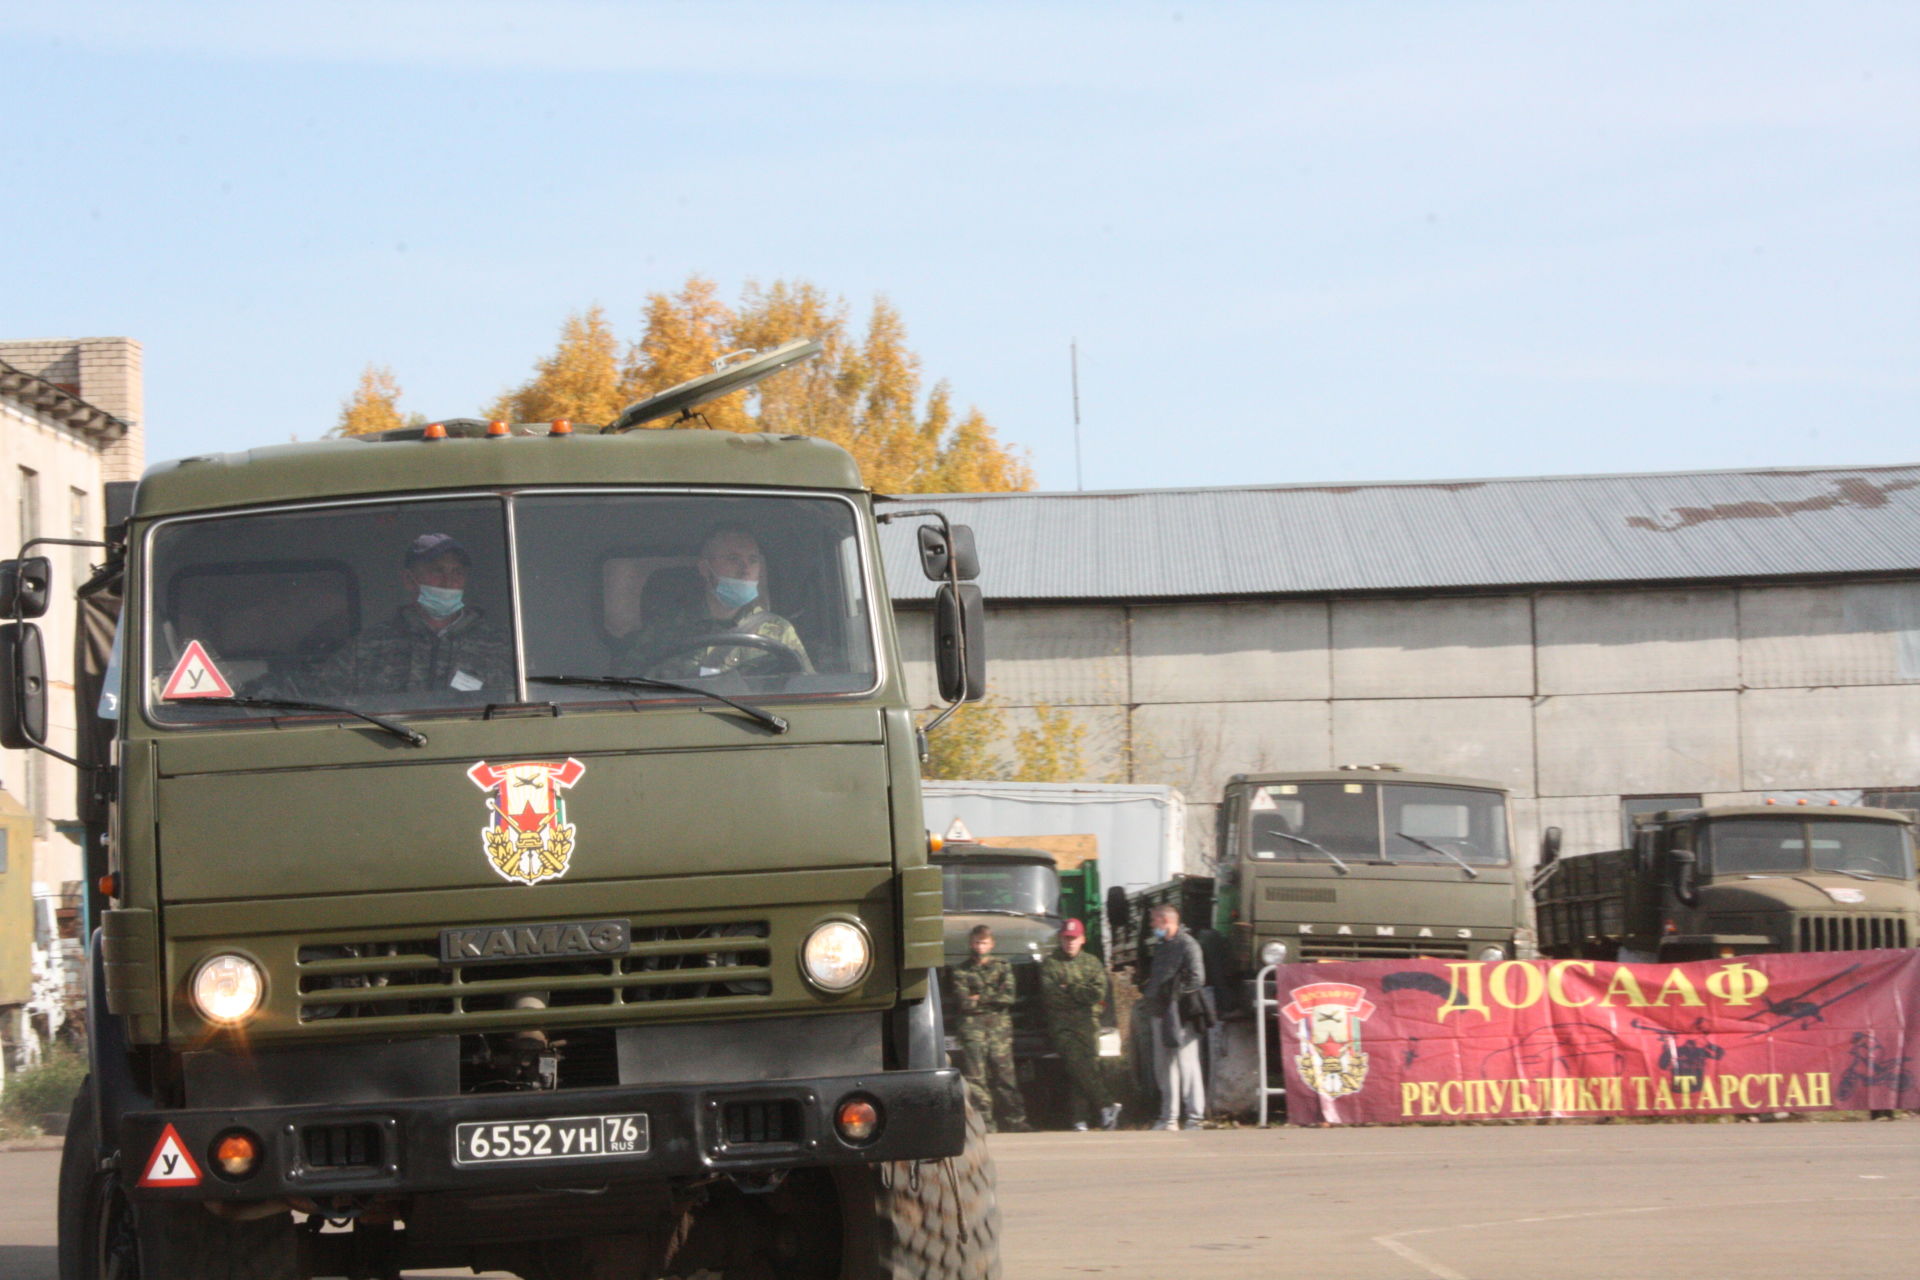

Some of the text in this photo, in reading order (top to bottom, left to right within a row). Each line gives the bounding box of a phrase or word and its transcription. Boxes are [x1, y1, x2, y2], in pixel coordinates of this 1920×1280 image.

[187, 668, 205, 690] У
[447, 922, 625, 960] КАМАЗ
[1298, 924, 1472, 939] КАМАЗ
[1437, 959, 1769, 1023] ДОСААФ
[1400, 1072, 1833, 1118] РЕСПУБЛИКИ ТАТАРСТАН
[470, 1118, 639, 1158] 6552 УН 76
[611, 1141, 635, 1151] RUS
[162, 1154, 179, 1176] У
